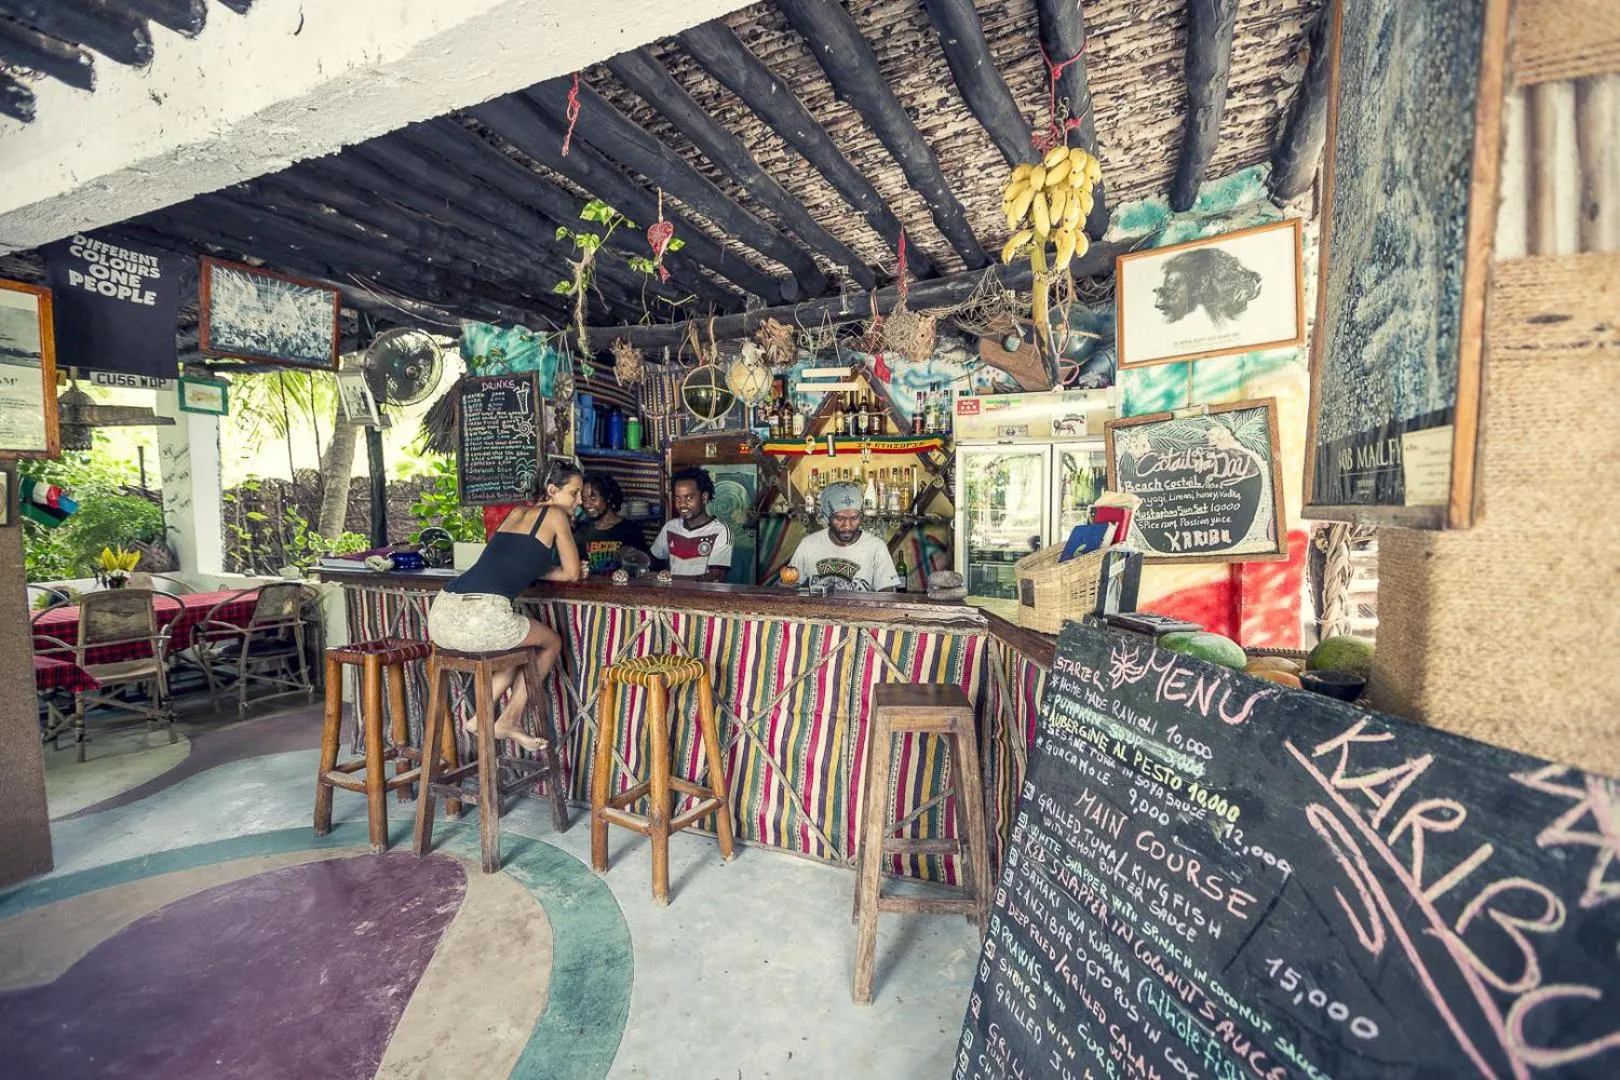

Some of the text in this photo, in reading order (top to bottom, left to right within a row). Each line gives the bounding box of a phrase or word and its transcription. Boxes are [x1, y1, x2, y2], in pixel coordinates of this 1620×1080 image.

[69, 245, 160, 278] COLOURS
[72, 234, 159, 267] DIFFERENT
[68, 269, 157, 306] PEOPLE
[89, 263, 141, 288] ONE
[96, 373, 136, 386] CU56
[482, 380, 515, 392] DRINKS
[1059, 676, 1082, 699] HOME
[1085, 687, 1108, 711] MADE
[1047, 723, 1087, 753] SESAME
[1048, 706, 1110, 753] AUBERGINE
[1133, 750, 1182, 791] PESTO
[1128, 788, 1170, 826] 9,000
[1073, 787, 1258, 920] MAIN COURSE
[1050, 858, 1109, 925] SNAPPER
[1111, 918, 1134, 943] IN
[1311, 714, 1620, 1068] KARIBU
[1007, 901, 1030, 929] DEEP
[1020, 860, 1060, 908] SAMAKI
[1088, 929, 1131, 984] KUPAKA
[1030, 823, 1062, 856] WHITE
[1112, 893, 1138, 922] WITH
[1141, 921, 1193, 969] SPINACH
[1194, 968, 1207, 984] IN
[1210, 980, 1272, 1034] COCONUT
[1038, 793, 1081, 834] GRILLED
[1265, 958, 1379, 1040] 15,000
[1148, 899, 1198, 943] SAUCE
[1002, 925, 1042, 986] PRAWNS
[1015, 881, 1073, 952] ZANZIBAR
[1076, 947, 1140, 1023] OCTOPUS
[1143, 1022, 1161, 1044] IN
[995, 982, 1042, 1045] GRILLED
